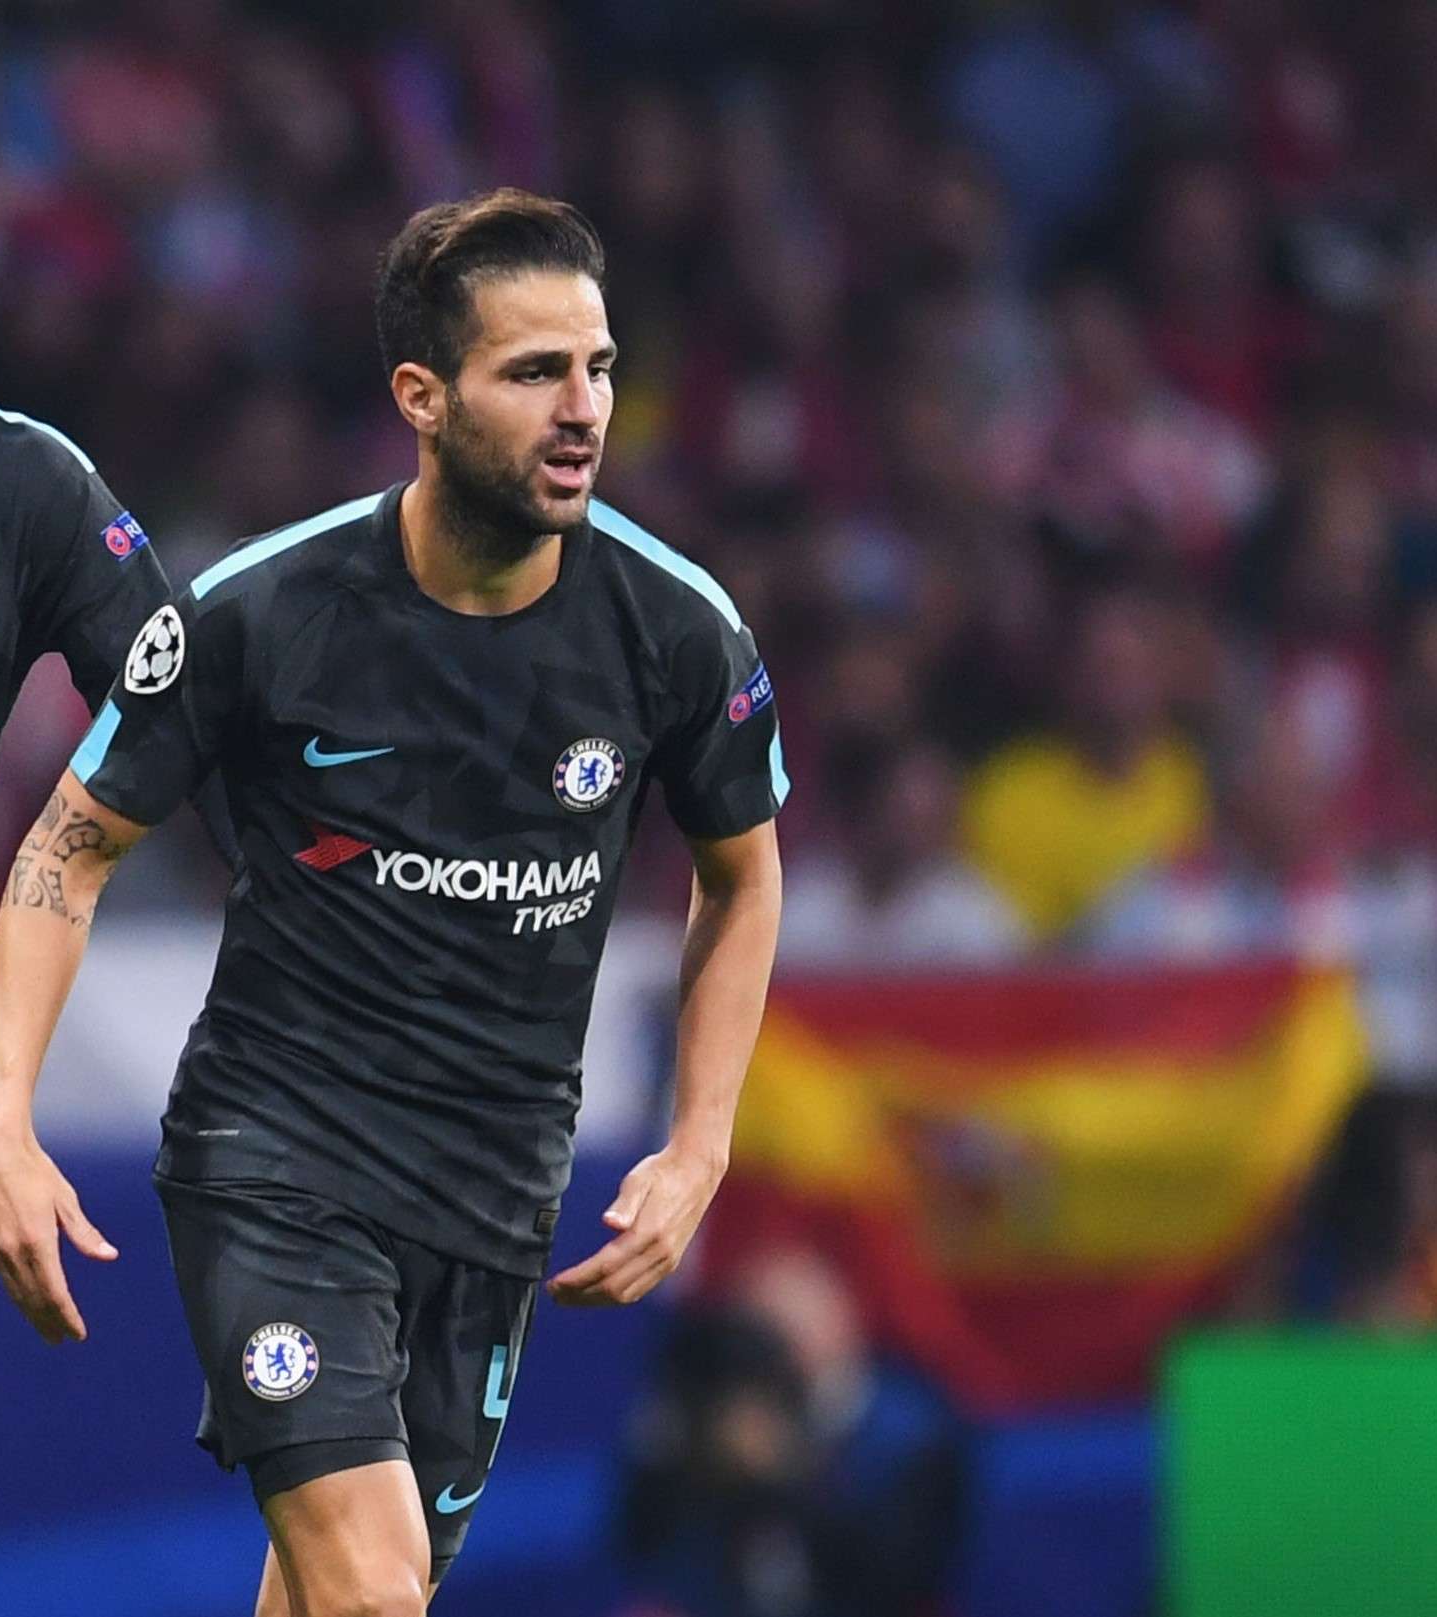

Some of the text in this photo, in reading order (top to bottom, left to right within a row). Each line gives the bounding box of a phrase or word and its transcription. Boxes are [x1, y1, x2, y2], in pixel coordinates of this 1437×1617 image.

[568, 741, 616, 758] CHELSEA
[371, 849, 601, 901] YOKOHAMA
[512, 889, 595, 934] TYRES
